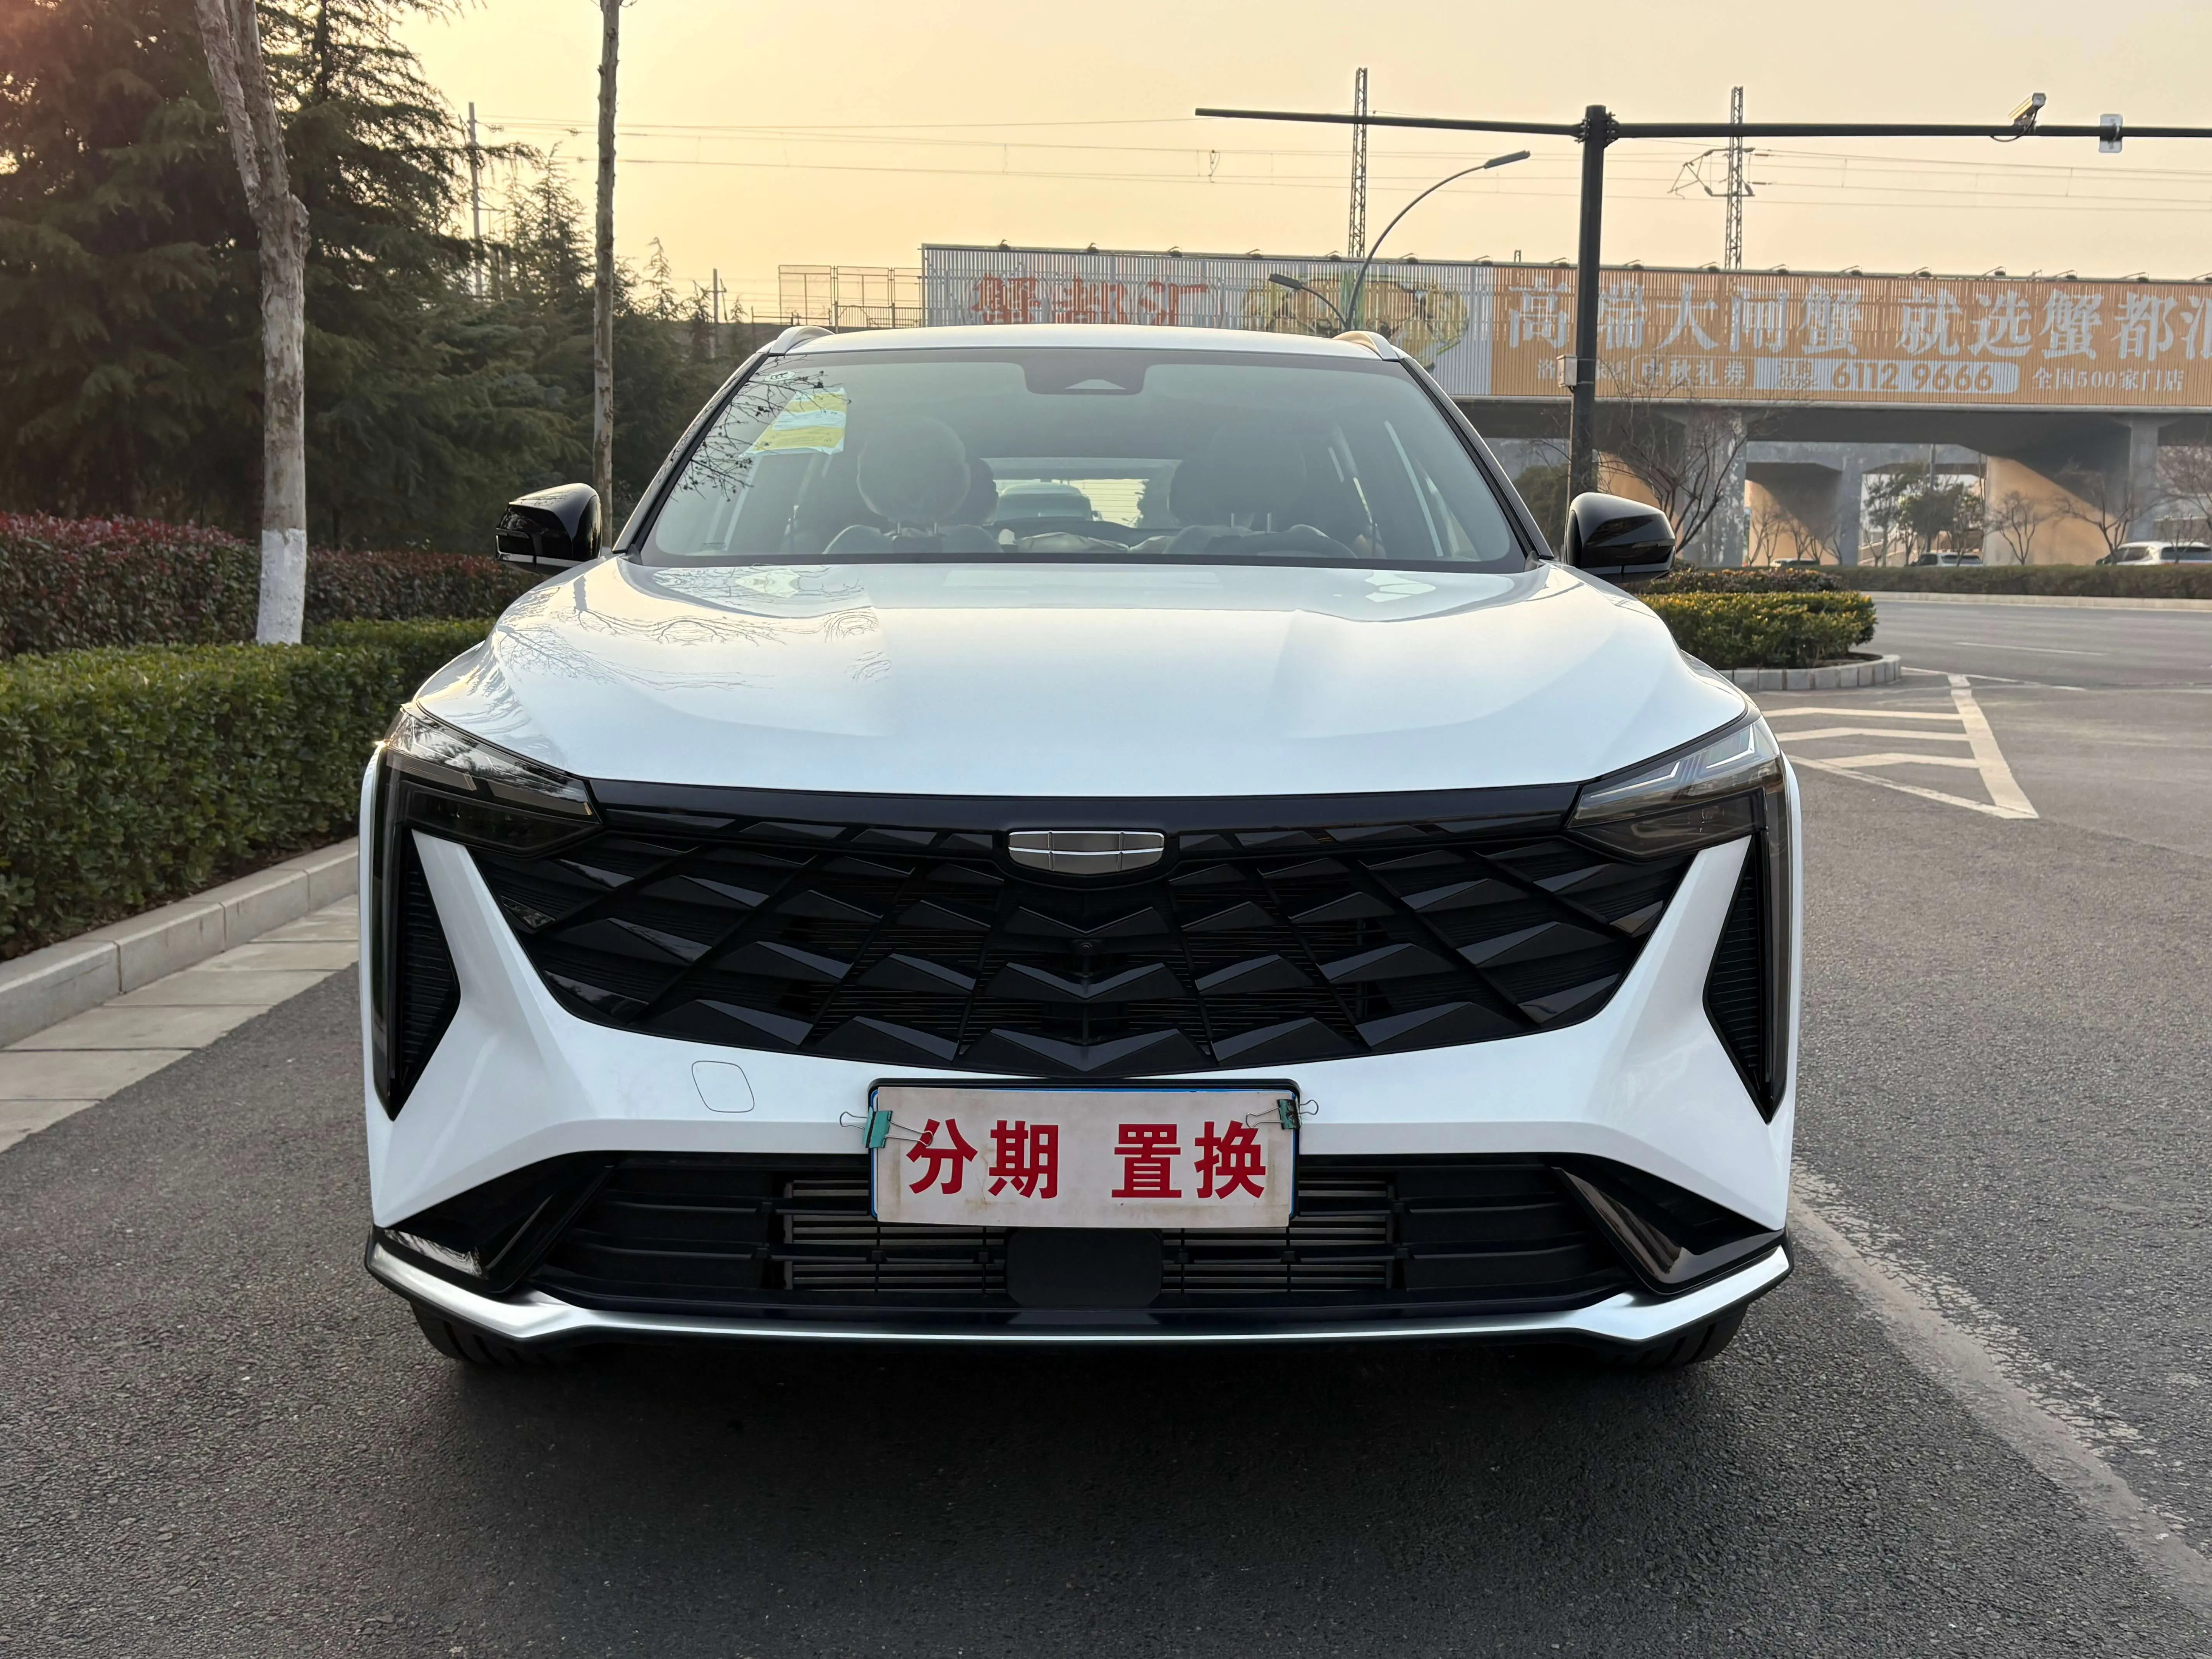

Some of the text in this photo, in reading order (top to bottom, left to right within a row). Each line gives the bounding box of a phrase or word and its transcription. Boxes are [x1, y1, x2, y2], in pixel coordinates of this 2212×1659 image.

[1833, 361, 1994, 392] 6112 9666
[2032, 366, 2185, 392] 全国500家门店
[906, 1118, 1266, 1199] 分期 置换
